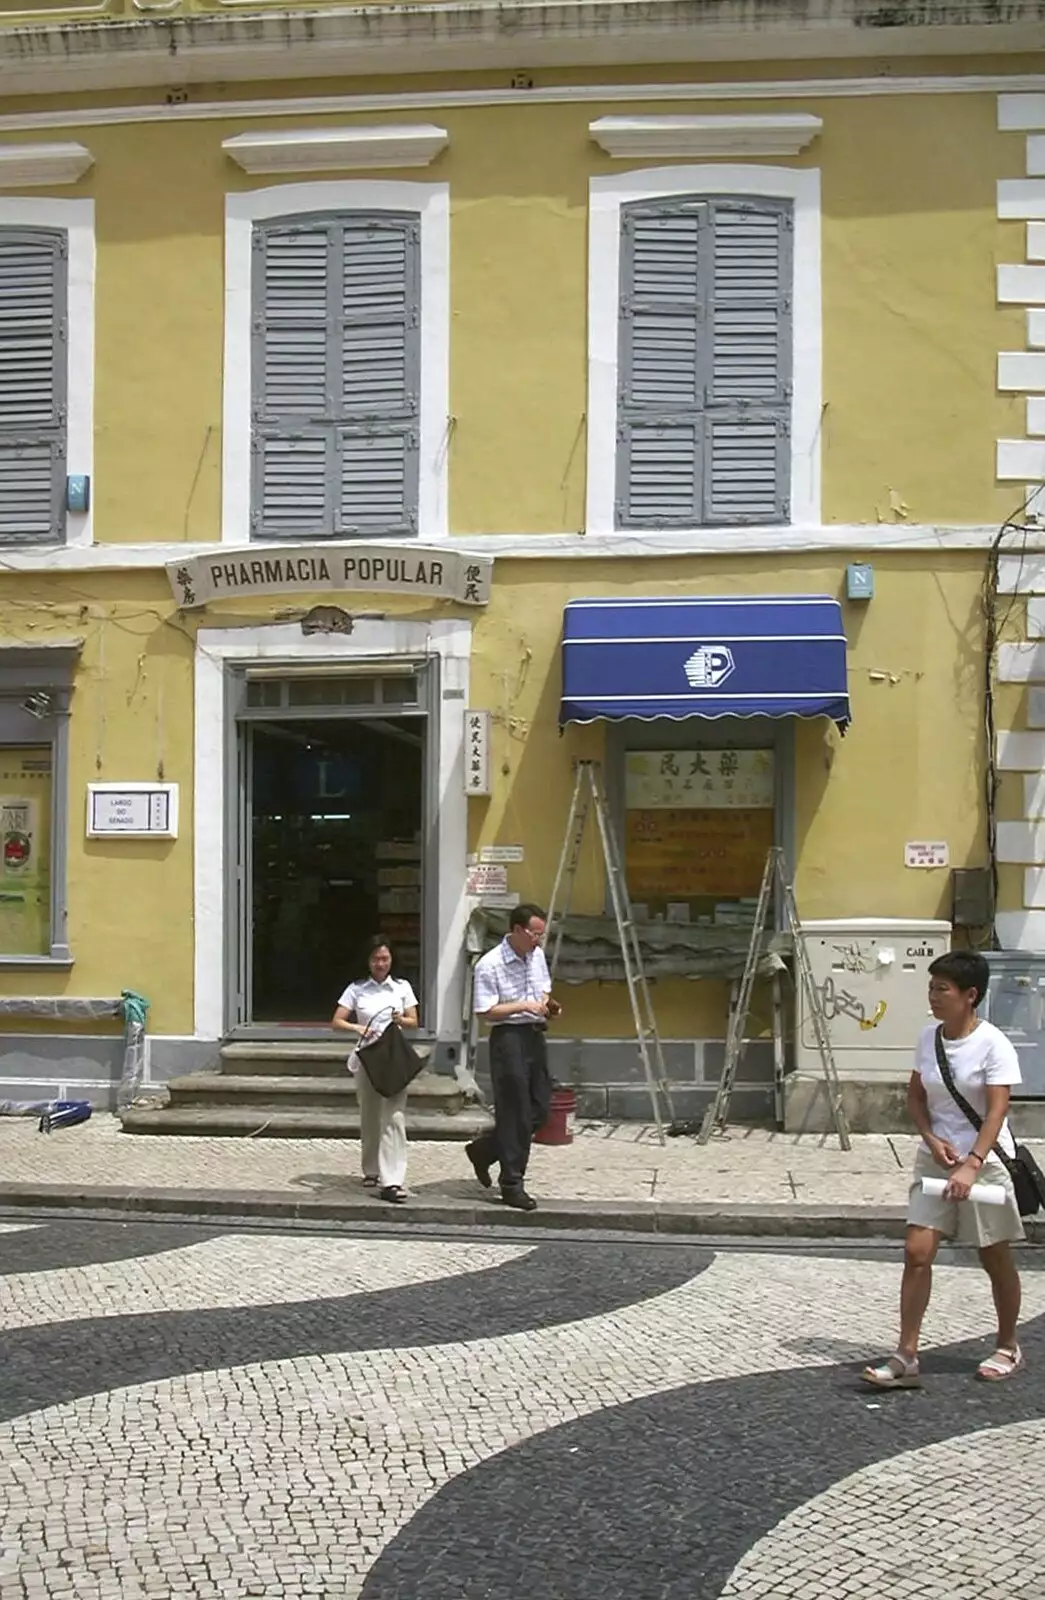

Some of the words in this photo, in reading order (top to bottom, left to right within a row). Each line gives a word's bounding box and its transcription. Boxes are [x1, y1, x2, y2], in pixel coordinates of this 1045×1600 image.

[210, 558, 331, 588] PHARMACIA
[344, 558, 443, 585] POPULAR
[464, 564, 483, 602] 便民
[854, 571, 867, 584] N
